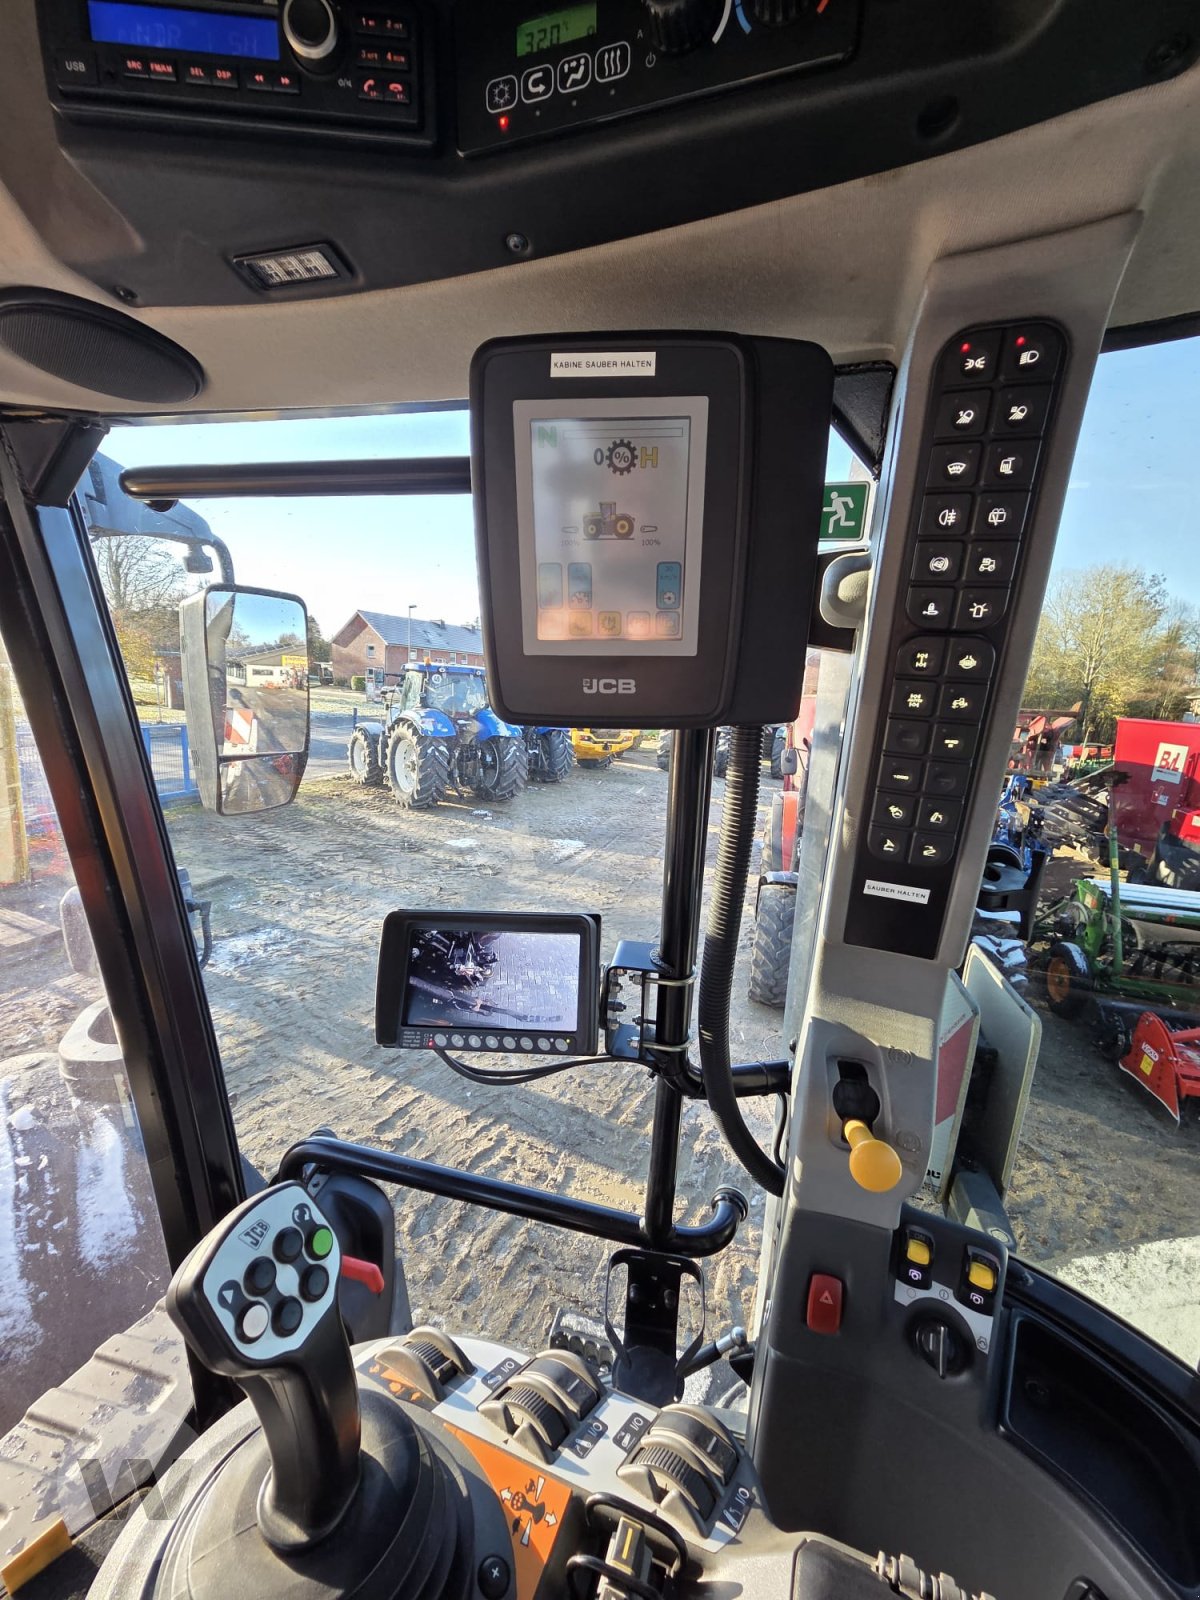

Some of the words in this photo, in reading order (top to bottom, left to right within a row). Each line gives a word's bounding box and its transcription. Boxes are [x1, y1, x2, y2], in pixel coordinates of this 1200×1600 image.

[65, 60, 86, 72] USB
[553, 361, 583, 369] KABINE
[585, 360, 618, 368] SAUBER
[620, 360, 652, 368] HALTEN
[537, 426, 558, 448] N
[640, 446, 659, 469] H
[641, 538, 661, 547] 100%
[582, 678, 636, 694] JCB
[866, 884, 895, 894] SAUBER
[897, 889, 926, 899] HALTEN
[243, 1221, 269, 1247] JCB
